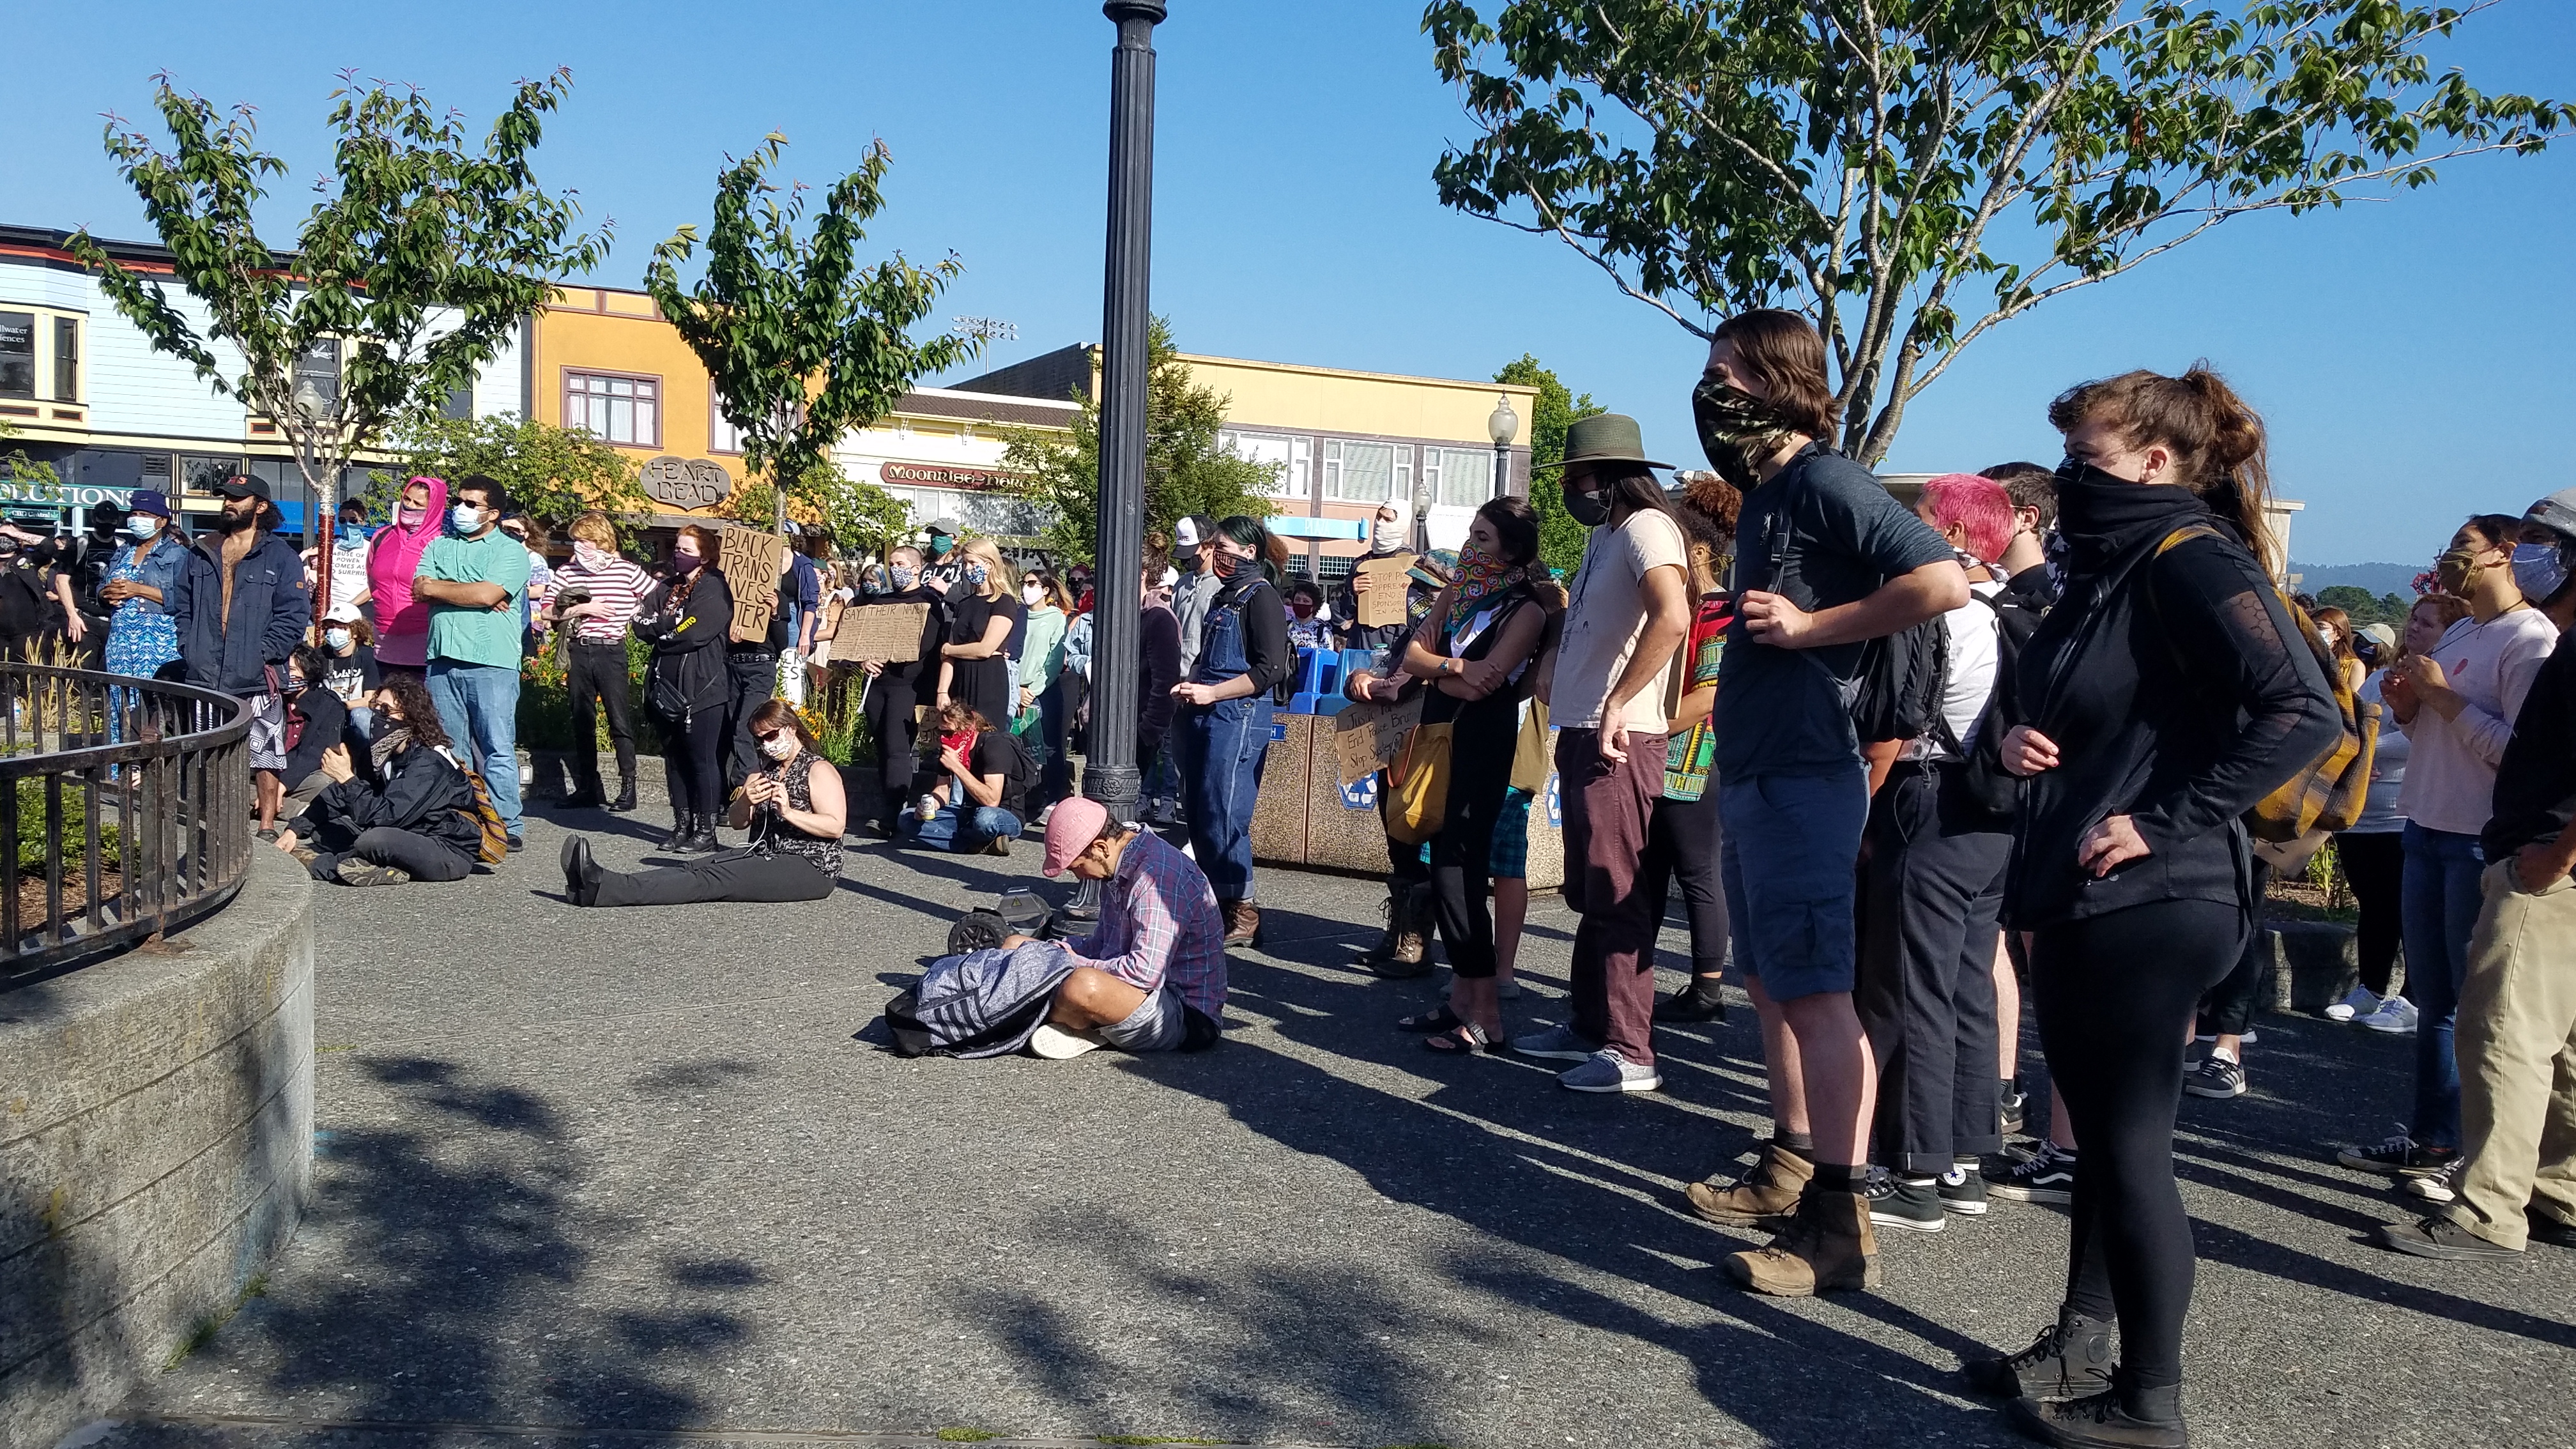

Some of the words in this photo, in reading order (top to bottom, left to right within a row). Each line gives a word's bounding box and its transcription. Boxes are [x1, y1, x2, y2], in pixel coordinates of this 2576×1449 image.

[648, 462, 723, 482] HEART
[657, 481, 717, 502] BEAD
[723, 528, 773, 562] BLACK
[721, 552, 773, 583] TRANS
[1370, 572, 1392, 583] STOP
[844, 607, 864, 621] SAY
[868, 605, 897, 617] THEIR
[1347, 729, 1364, 750] End
[1367, 723, 1389, 739] Police
[1350, 752, 1367, 768] Stop
